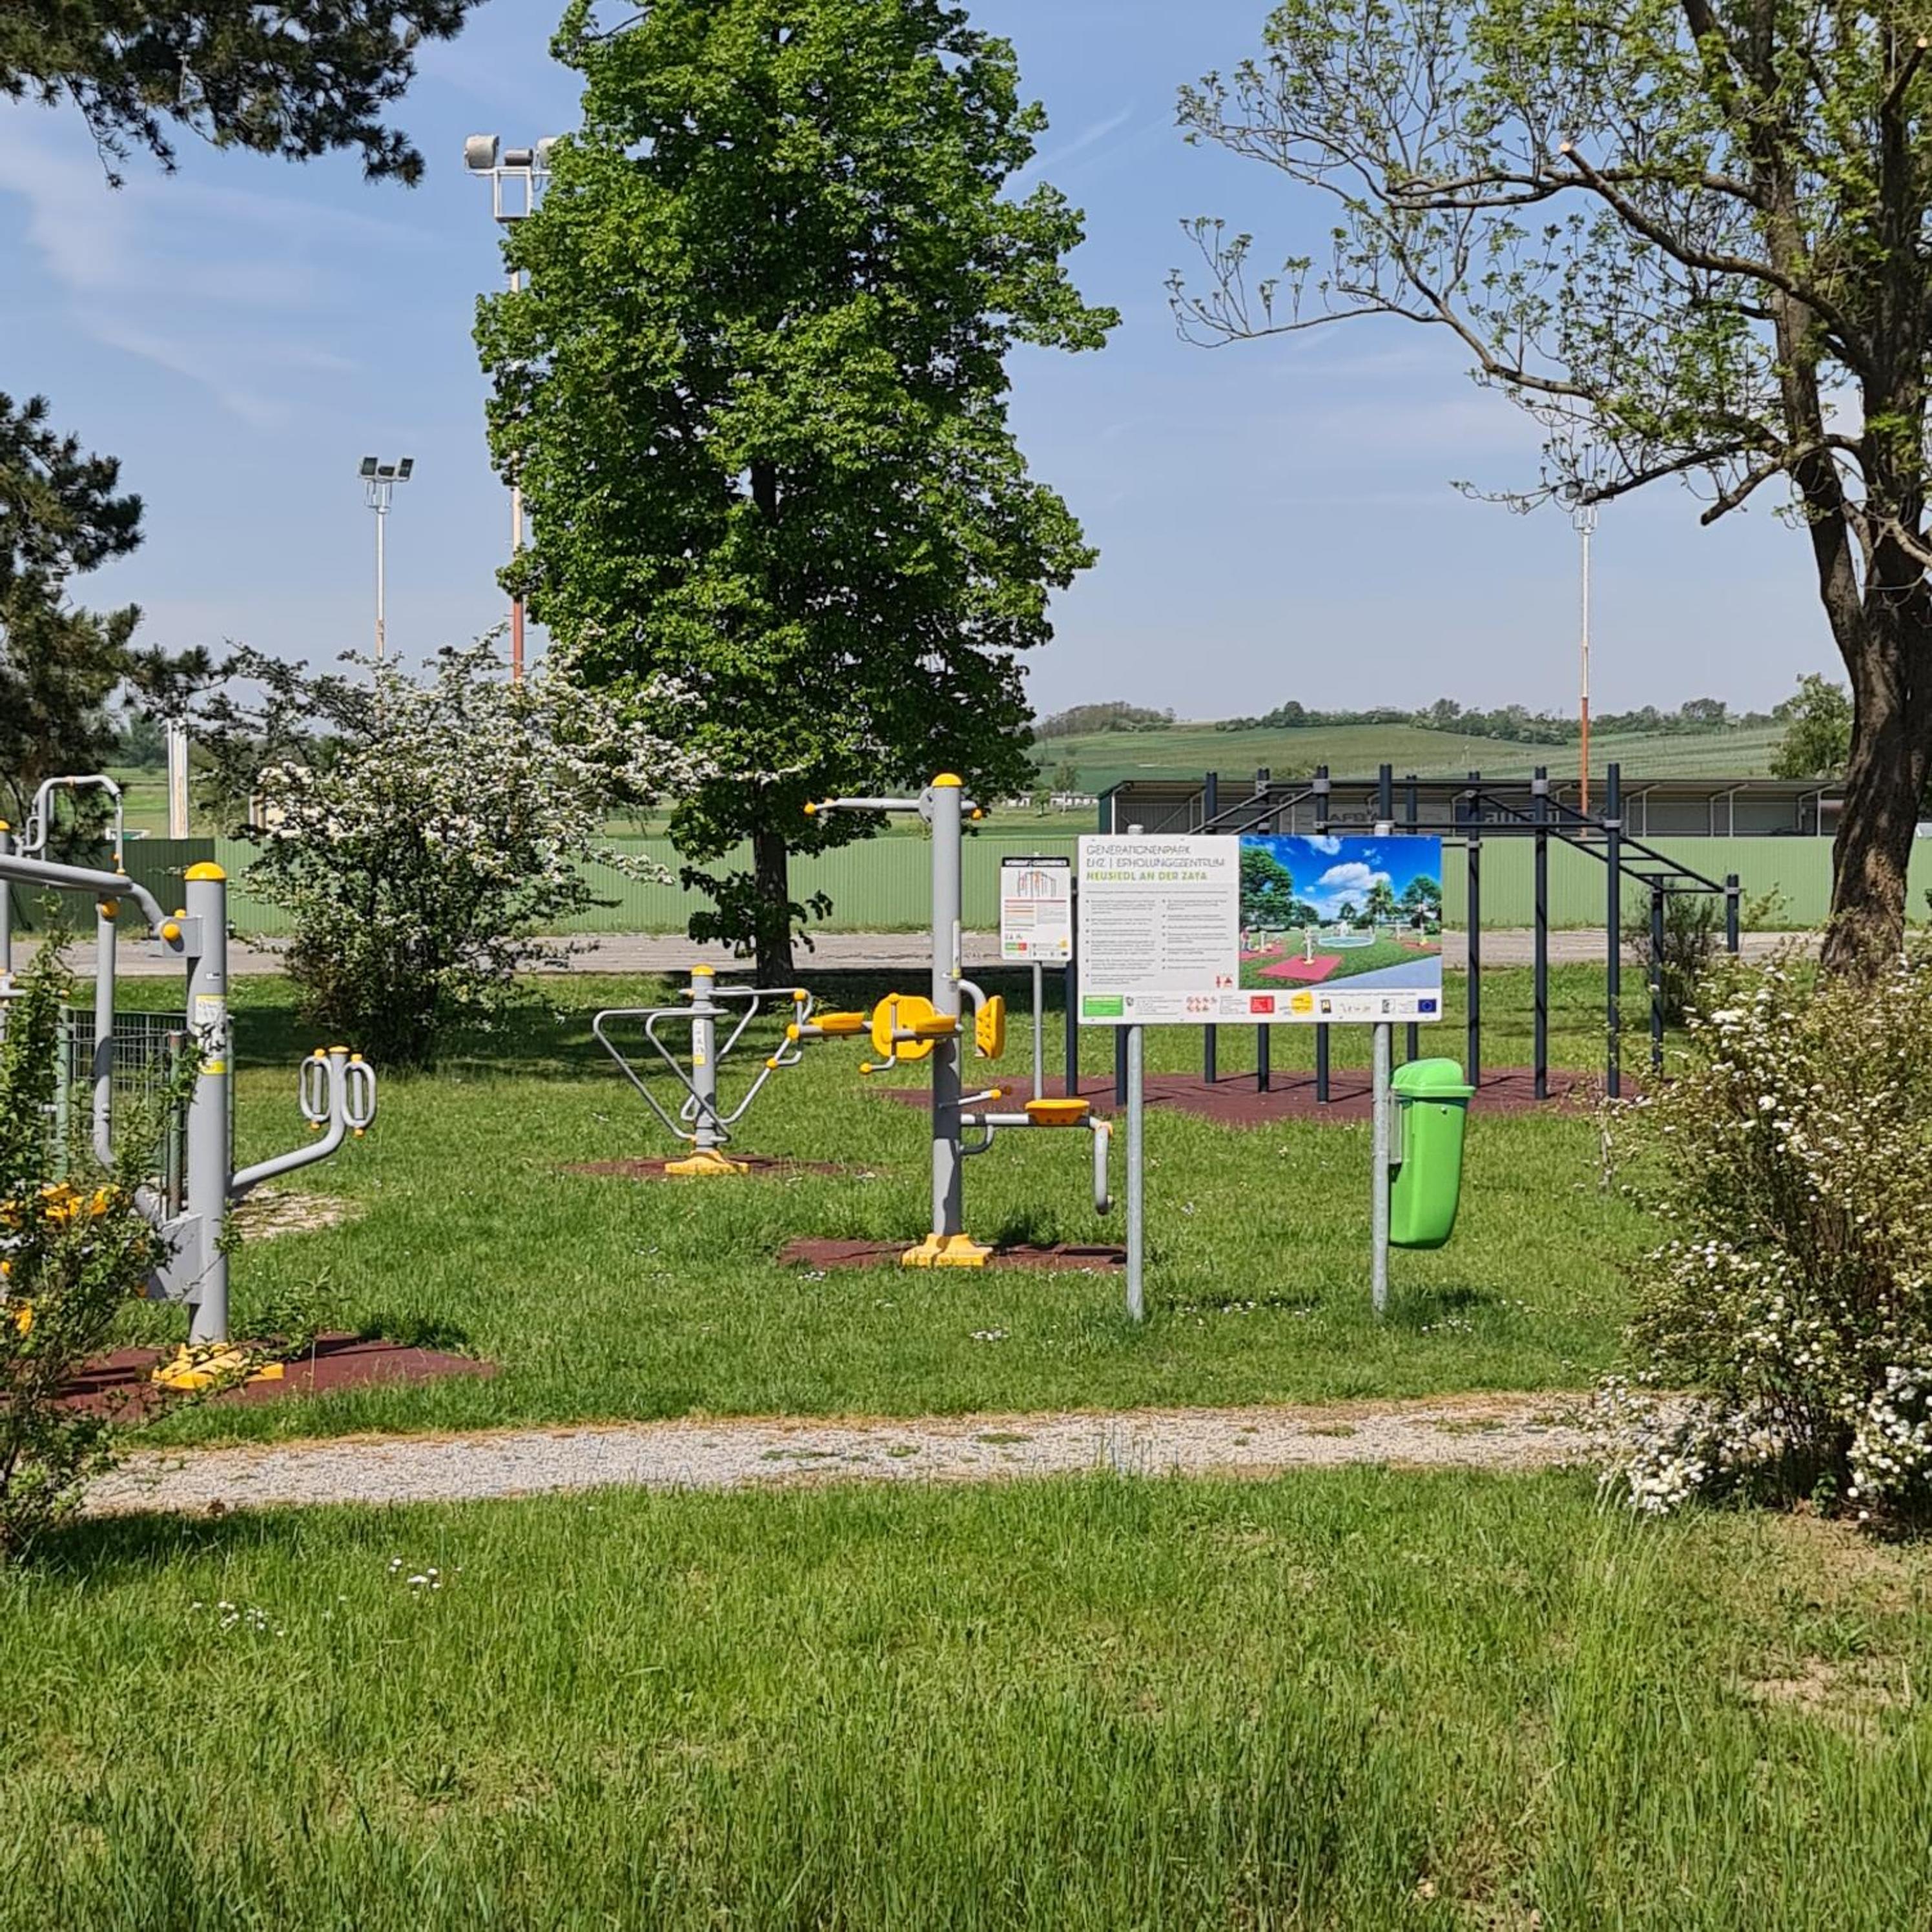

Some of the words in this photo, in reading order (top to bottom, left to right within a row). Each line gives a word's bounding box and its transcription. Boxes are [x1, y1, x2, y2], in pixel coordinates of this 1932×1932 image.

[1086, 845, 1191, 855] GENERATIONENPARK
[1086, 872, 1136, 881] NEUSIEDL
[1139, 872, 1155, 881] AN
[1158, 872, 1179, 881] DER
[1182, 872, 1208, 881] ZAYA
